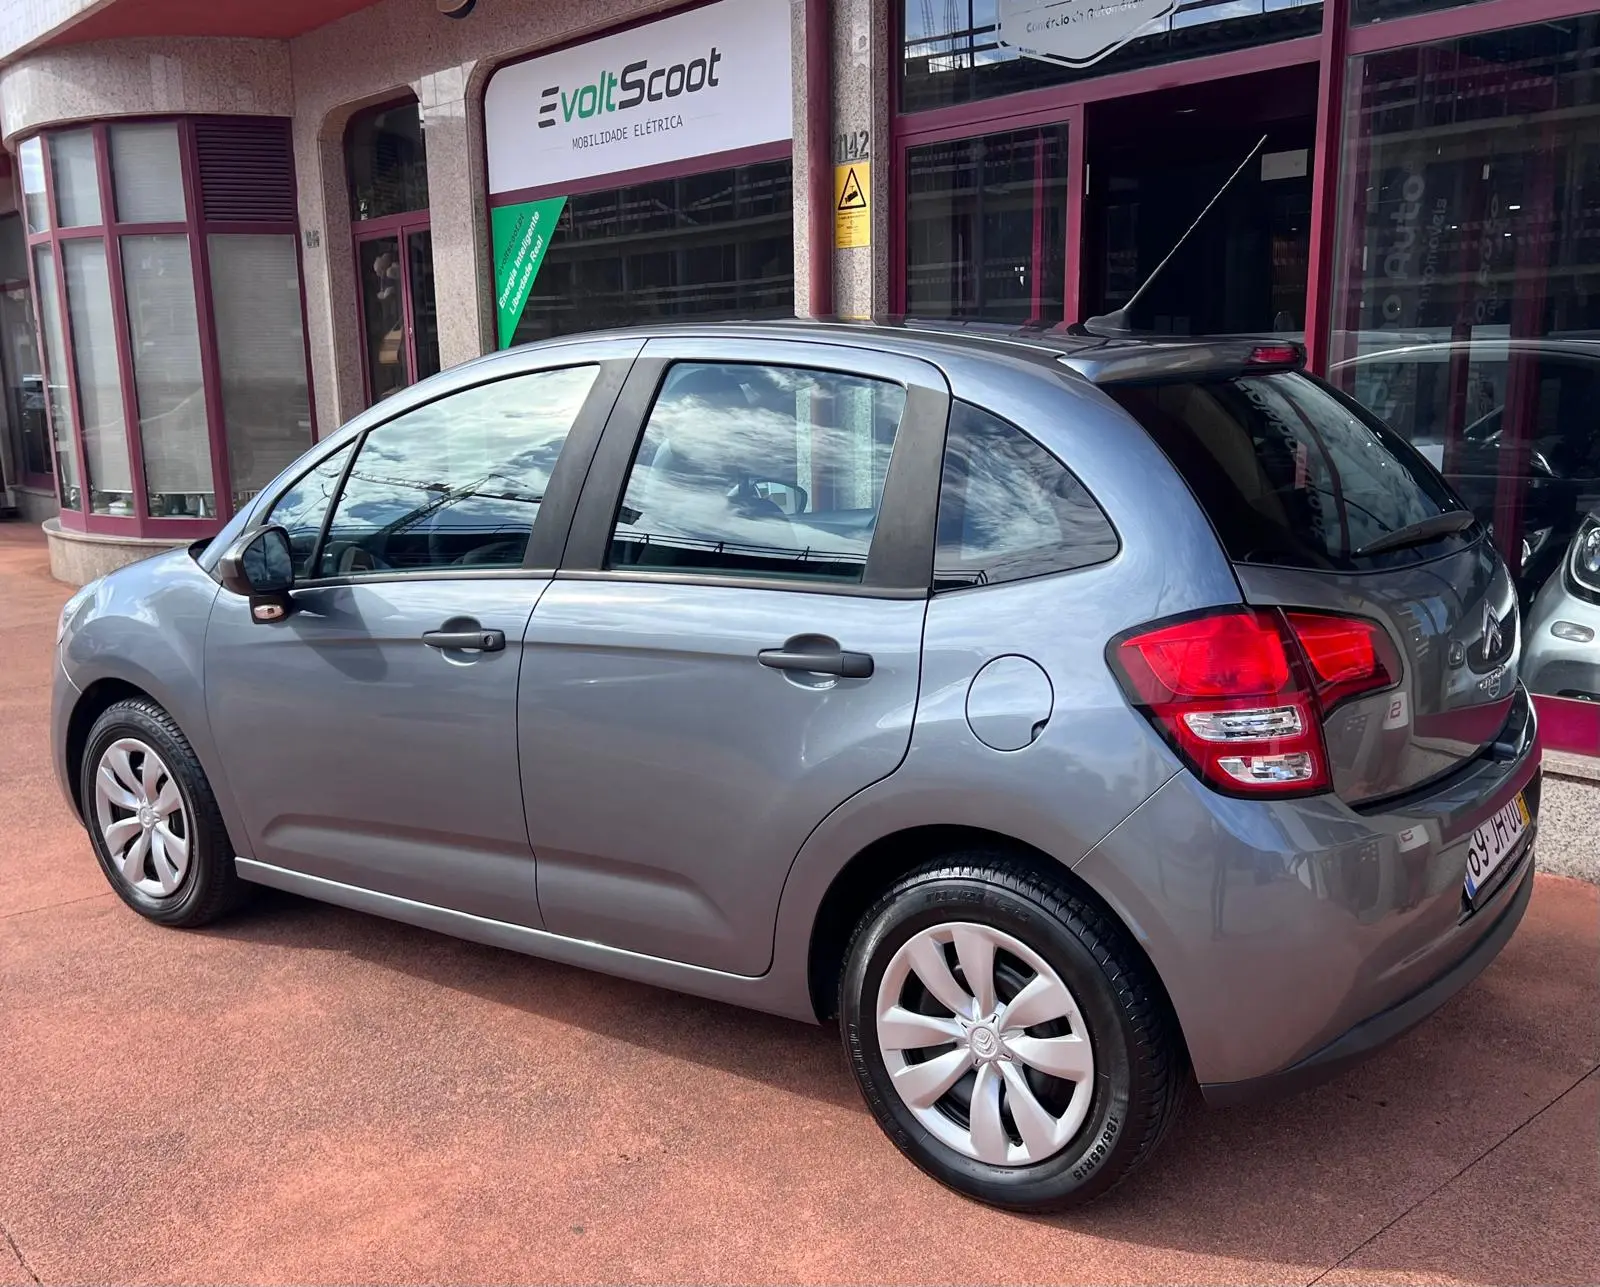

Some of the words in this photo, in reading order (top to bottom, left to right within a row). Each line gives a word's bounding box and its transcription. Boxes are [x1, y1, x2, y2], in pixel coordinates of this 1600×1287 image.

[538, 47, 722, 129] EvoltScoot
[572, 126, 628, 151] MOBILIDADE
[634, 115, 684, 137] ELÉTRICA
[498, 268, 518, 310] Energia
[513, 211, 540, 269] Inteligente
[508, 262, 533, 316] Liberdade
[529, 234, 544, 263] Real
[1072, 1113, 1120, 1181] 185/65R15
